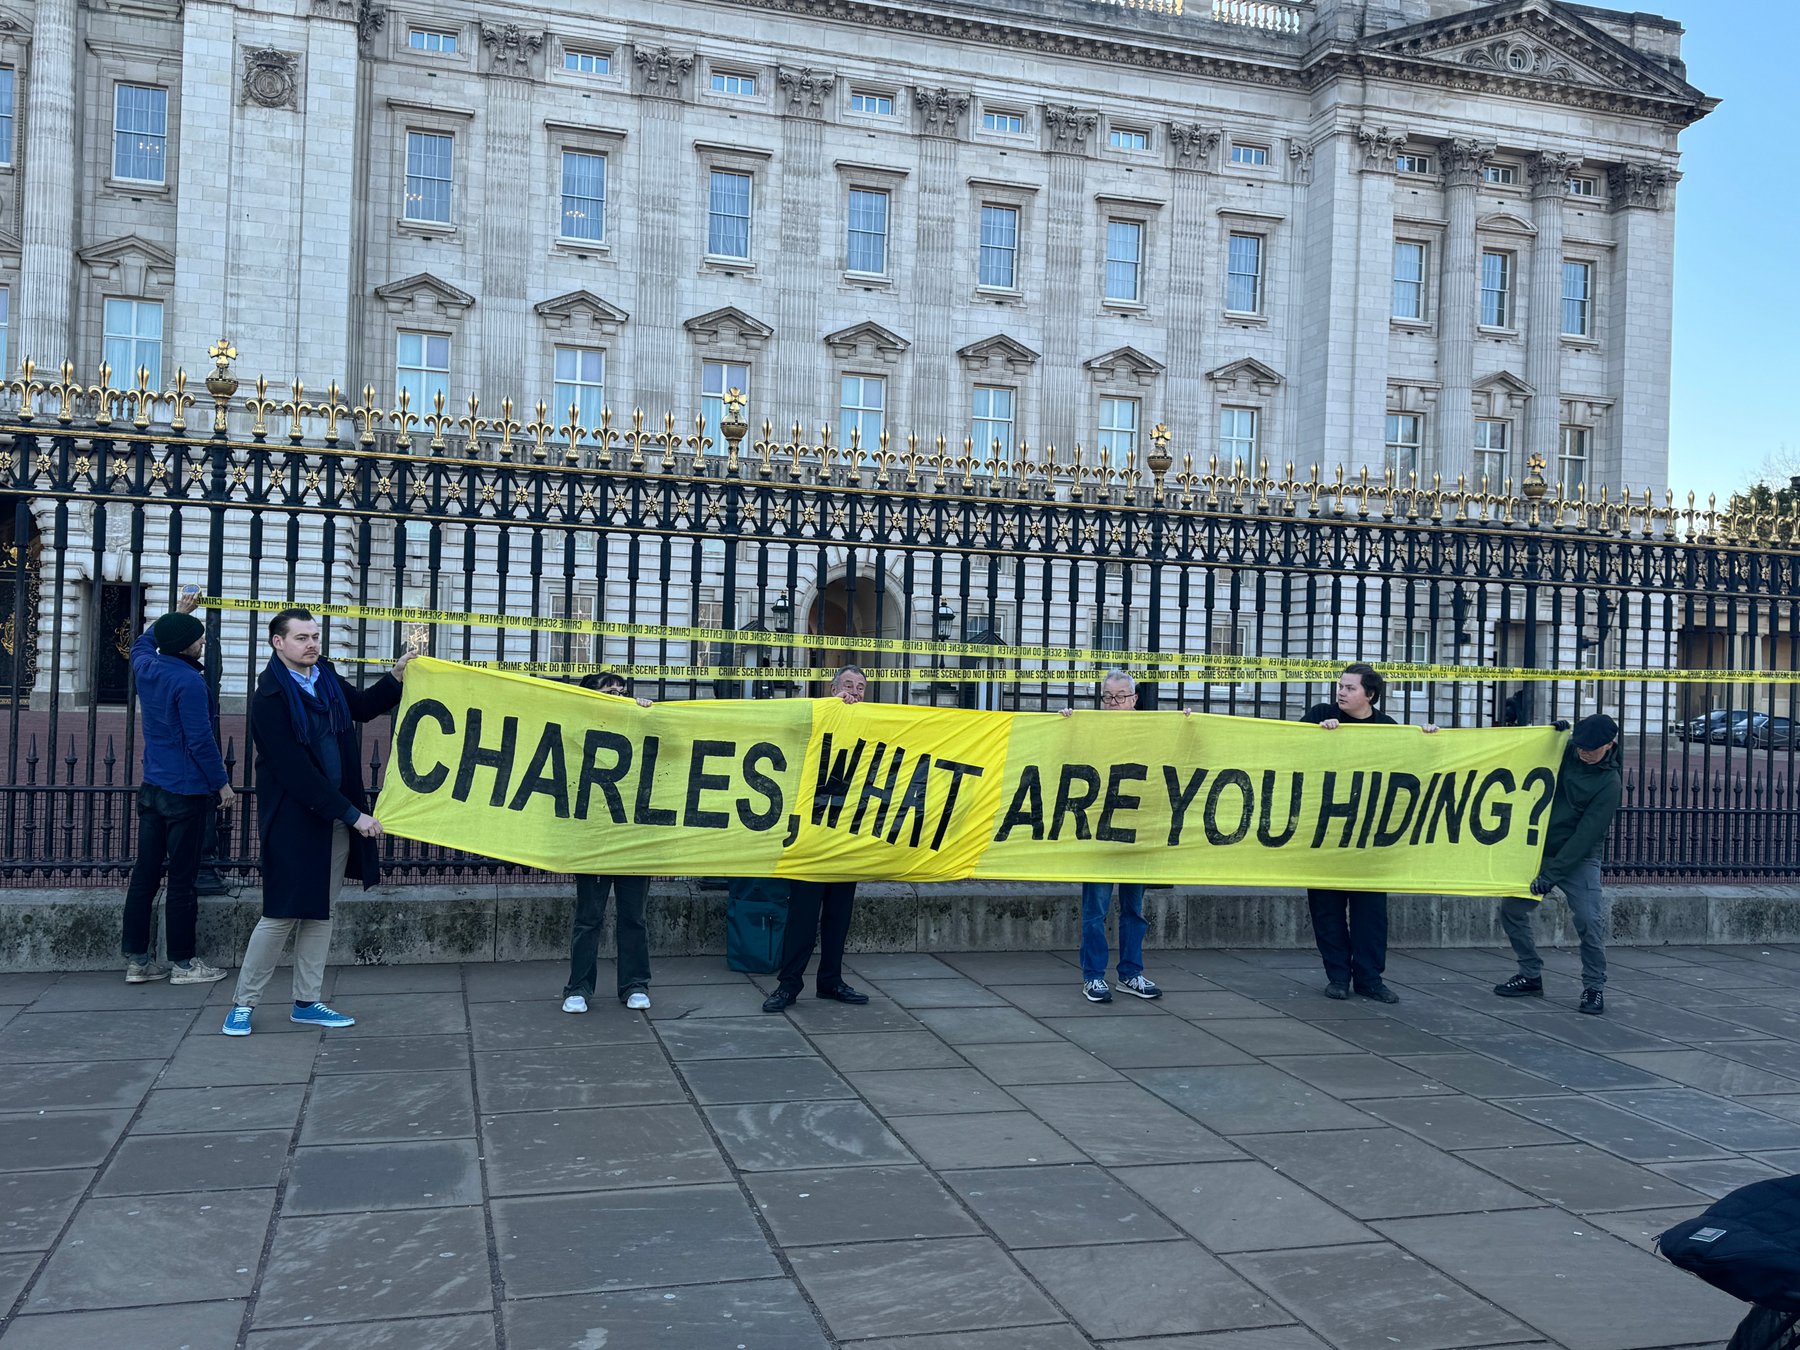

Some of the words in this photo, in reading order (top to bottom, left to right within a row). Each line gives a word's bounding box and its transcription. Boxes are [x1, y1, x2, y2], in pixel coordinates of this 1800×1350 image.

[498, 661, 520, 670] CRIME
[524, 662, 546, 671] SCENE
[549, 663, 558, 671] DO
[561, 663, 575, 672] NOT
[577, 664, 600, 672] ENTER
[611, 665, 632, 674] CRIME
[635, 665, 657, 674] SCENE
[659, 666, 668, 674] DO
[671, 666, 683, 674] NOT
[686, 666, 708, 675] ENTER
[718, 667, 739, 675] CRIME
[741, 667, 762, 676] SCENE
[764, 667, 772, 676] DO
[775, 668, 788, 676] NOT
[789, 668, 811, 676] ENTER
[820, 668, 837, 677] CRIM
[865, 669, 874, 677] DO
[876, 669, 888, 677] NOT
[890, 669, 910, 678] ENTER
[919, 669, 938, 677] CRIME
[940, 669, 960, 678] SCENE
[962, 669, 970, 678] DO
[972, 669, 984, 678] NOT
[986, 670, 1006, 678] ENTER
[1015, 670, 1033, 678] CRIME
[1036, 670, 1054, 678] SCENE
[1056, 670, 1064, 678] DO
[1066, 670, 1078, 678] NOT
[1080, 670, 1099, 678] ENTER
[1127, 670, 1146, 678] SCENE
[397, 698, 800, 847] CHARLES,
[811, 733, 984, 851] WHAT
[994, 763, 1148, 843] ARE
[1162, 766, 1303, 848] YOU
[1310, 766, 1556, 849] HIDING?
